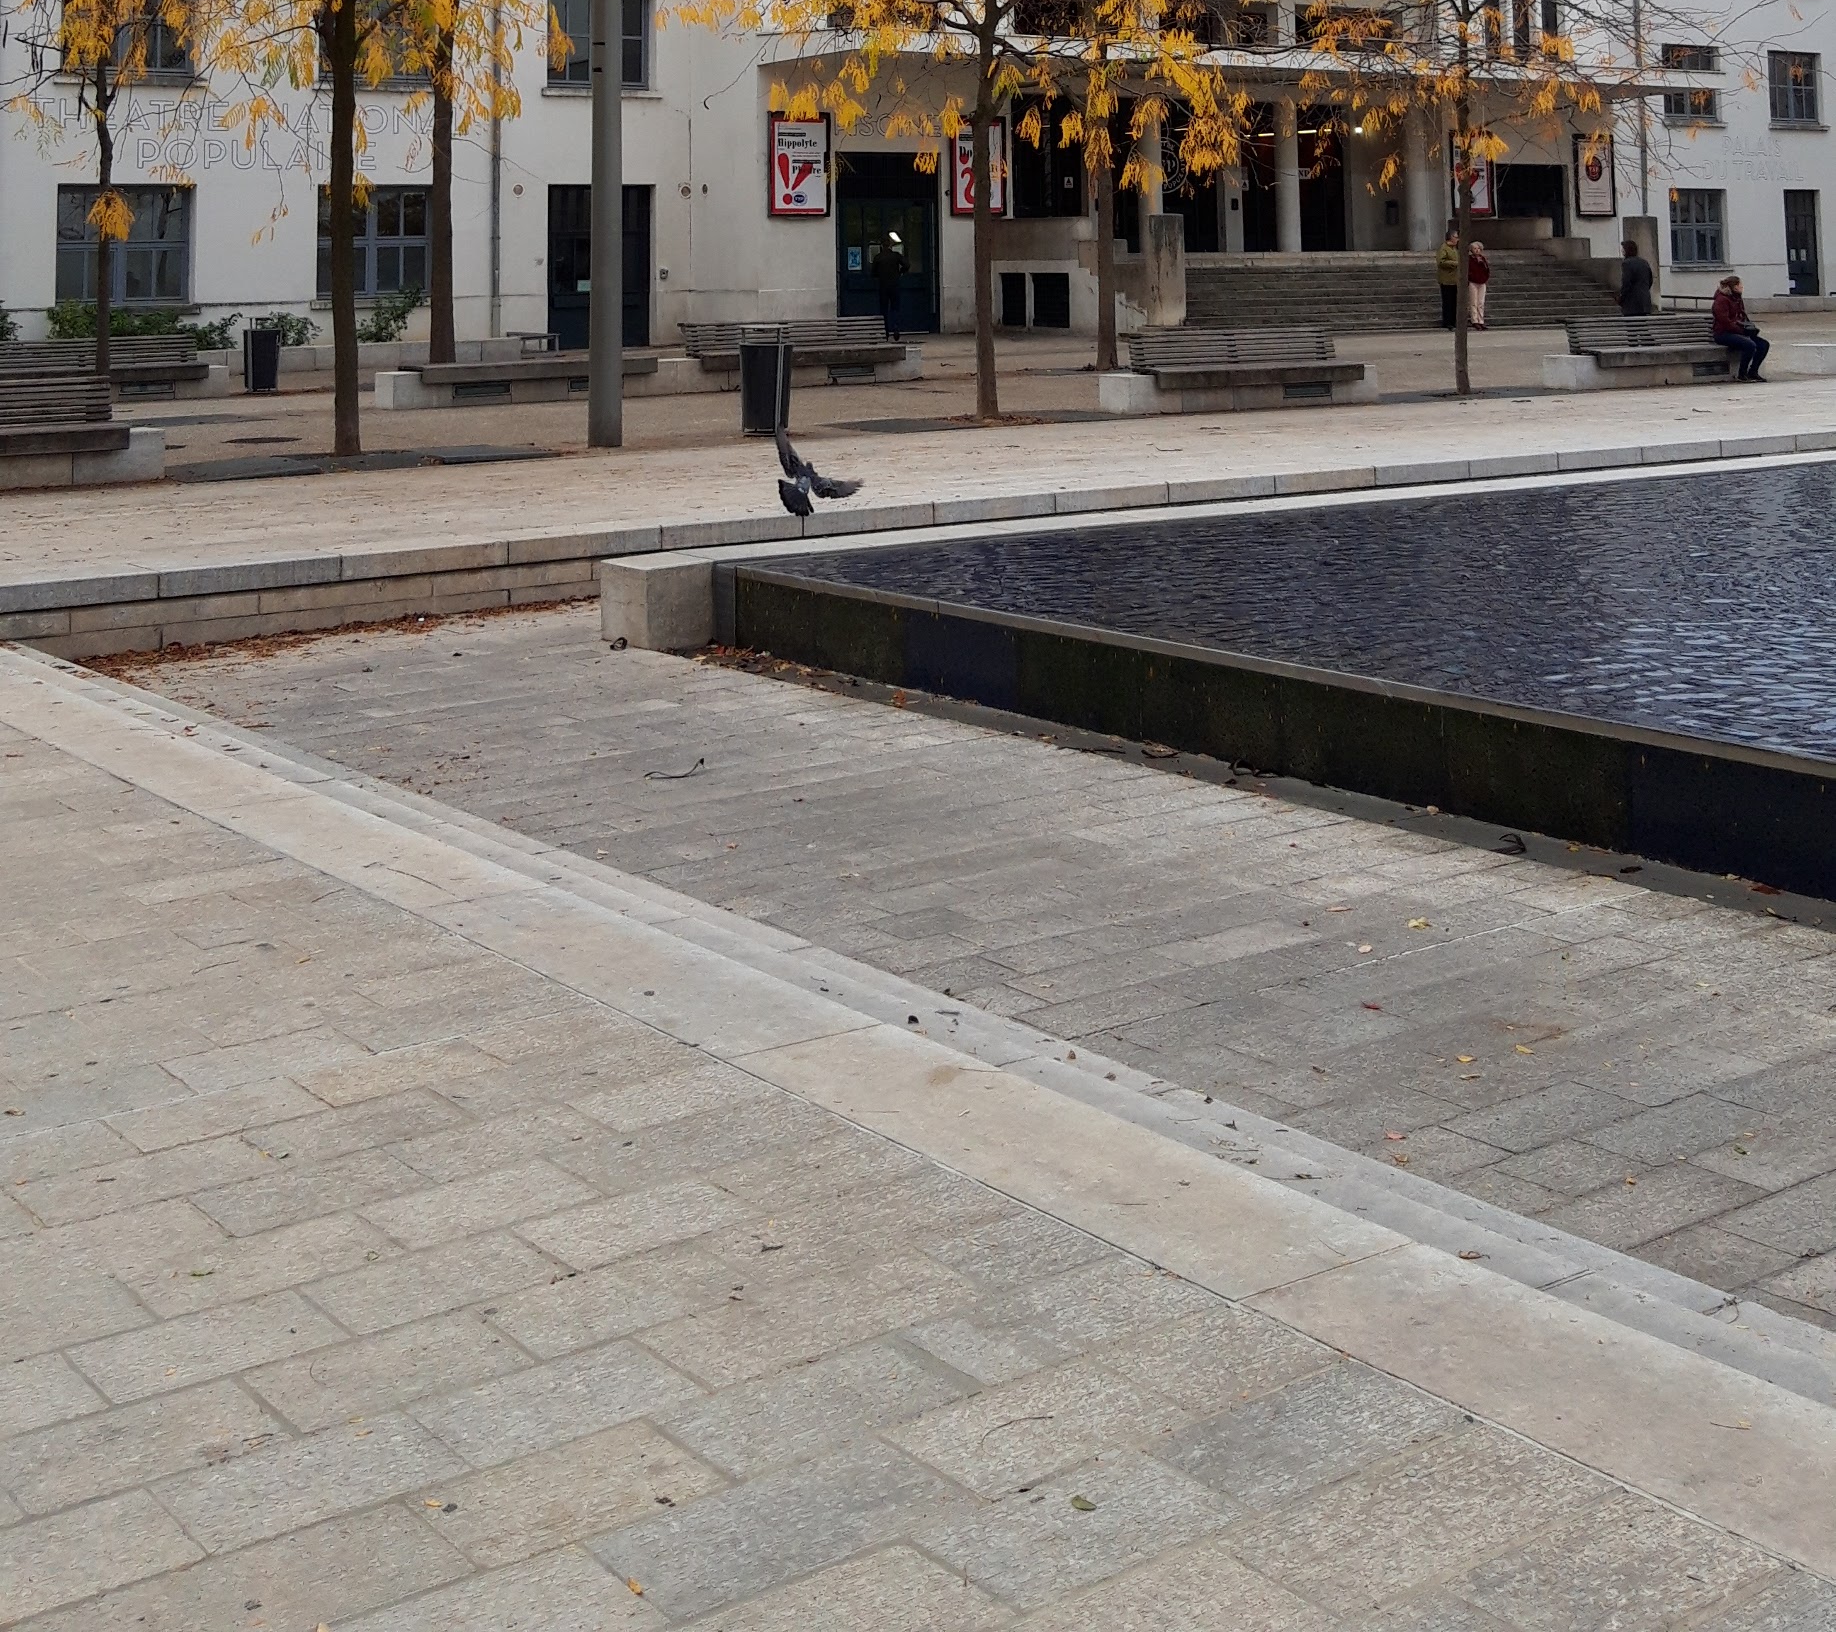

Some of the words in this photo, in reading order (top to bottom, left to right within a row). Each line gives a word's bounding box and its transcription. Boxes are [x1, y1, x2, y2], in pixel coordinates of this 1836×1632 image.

[263, 102, 469, 135] NATONL
[136, 138, 377, 171] POPULAIE
[777, 137, 818, 149] Hippolyte
[1722, 135, 1782, 158] PALAIS
[1702, 159, 1728, 180] DU
[1732, 160, 1804, 182] TRAVAIL
